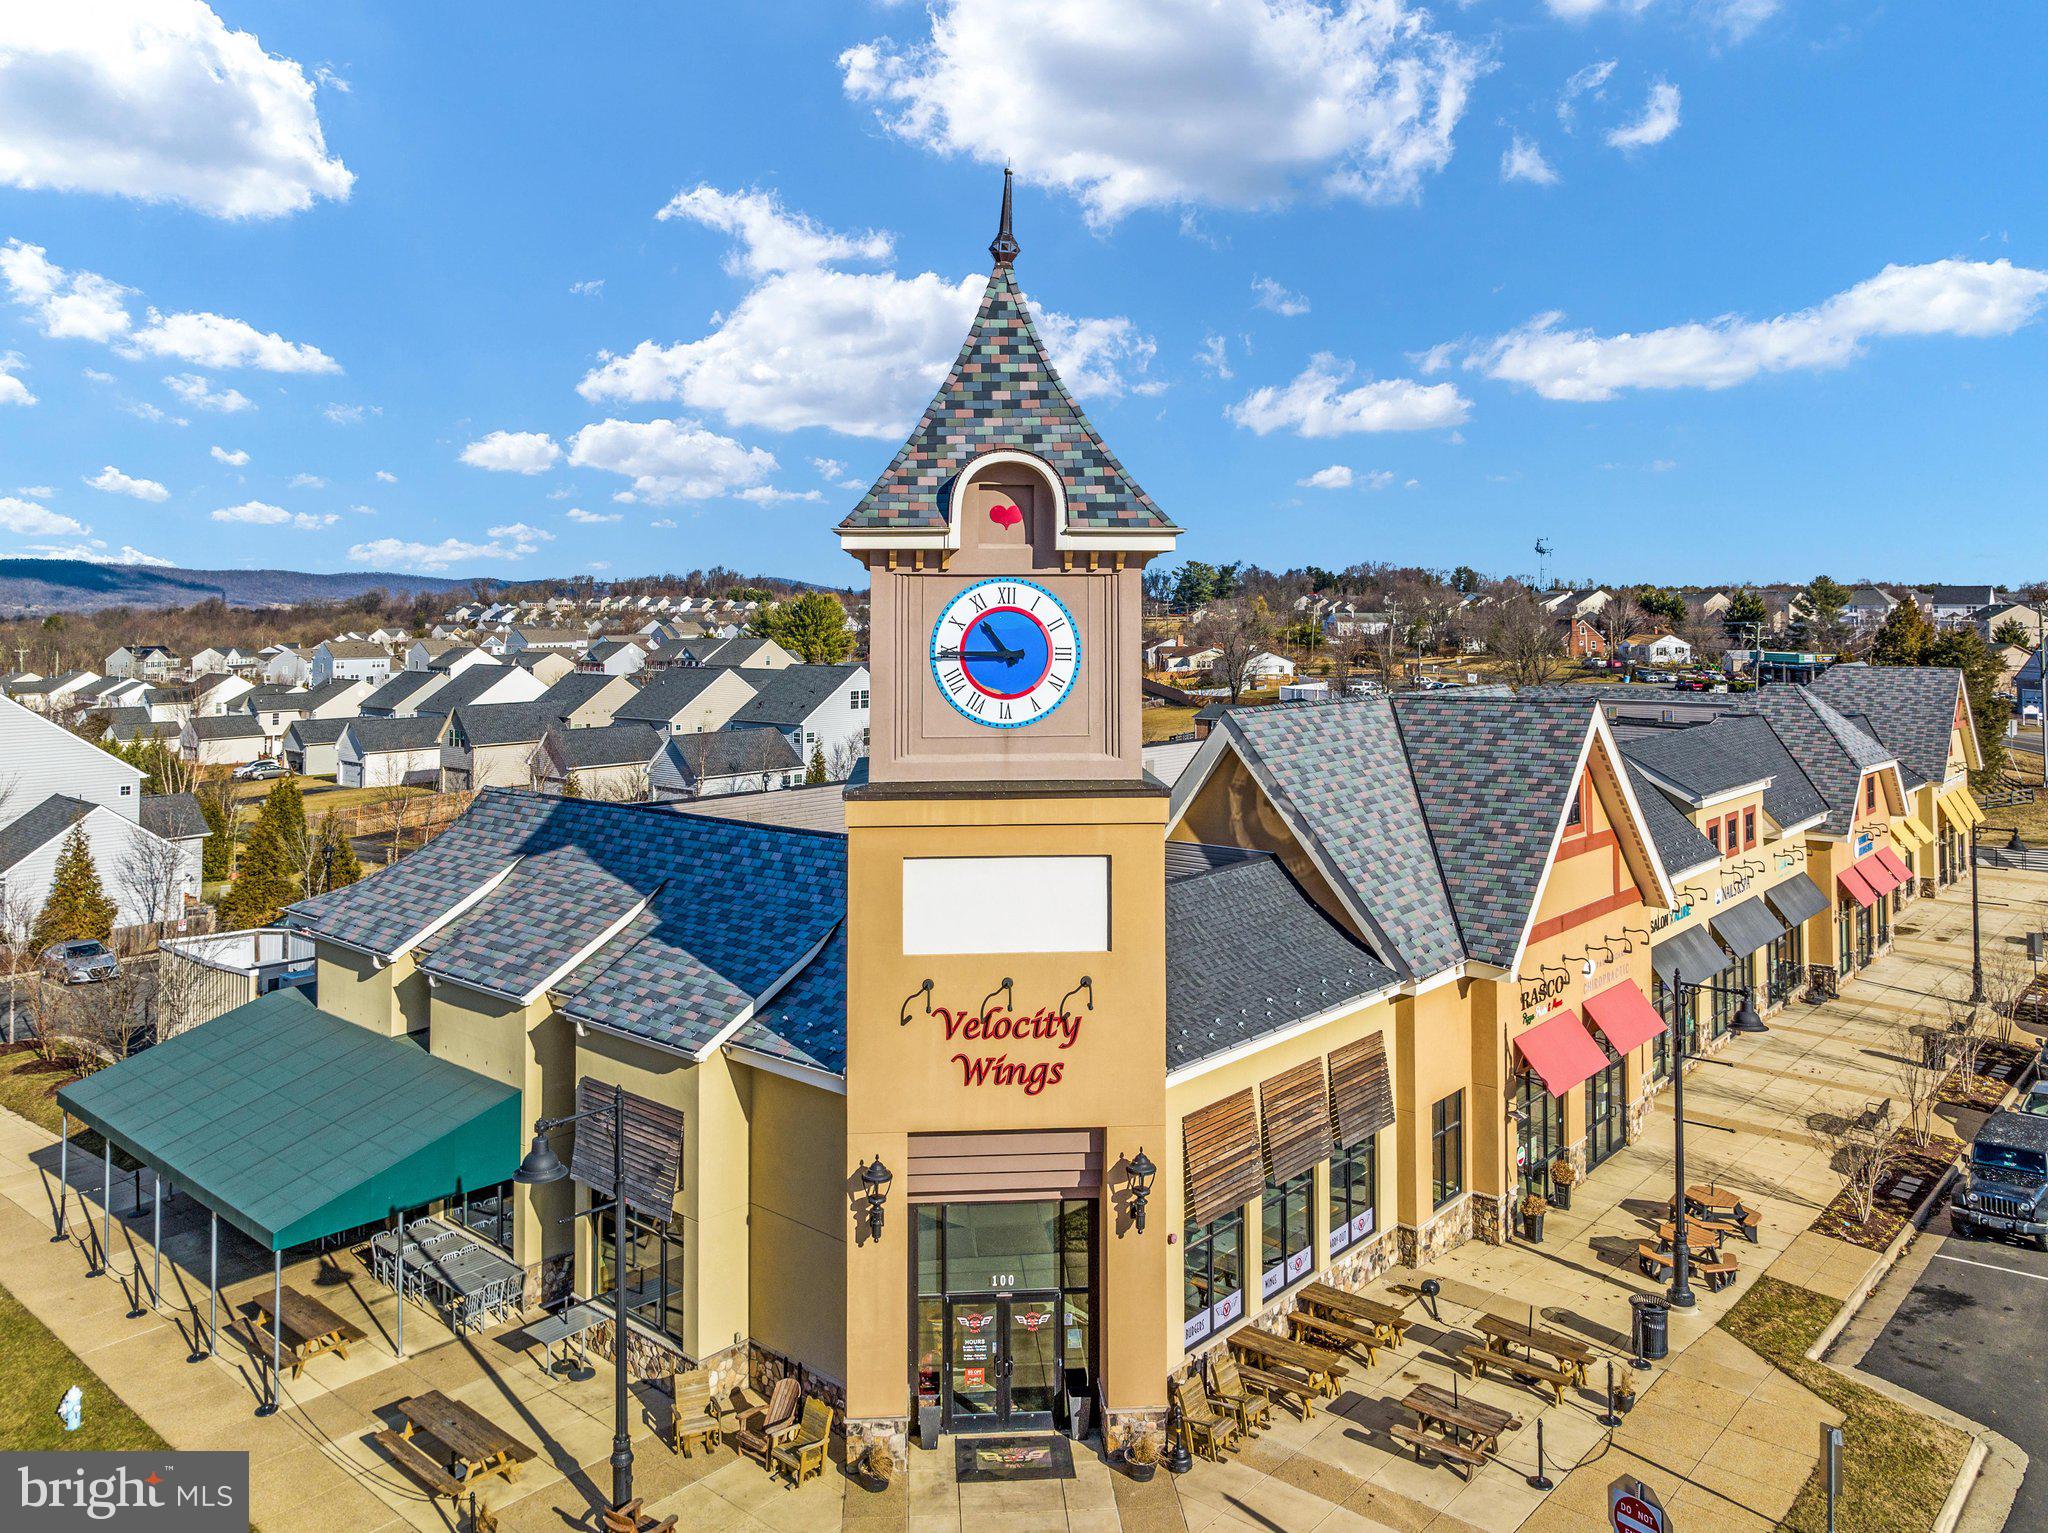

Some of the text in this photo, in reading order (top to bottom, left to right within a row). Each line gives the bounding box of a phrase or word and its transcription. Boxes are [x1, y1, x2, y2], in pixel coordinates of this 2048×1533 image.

[969, 593, 987, 613] XI
[998, 587, 1016, 604] XII
[1030, 596, 1041, 611] I
[948, 616, 966, 631] X
[1047, 617, 1065, 632] II
[1055, 647, 1072, 661] III
[943, 667, 967, 695] VIII
[1047, 673, 1065, 692] IV
[965, 691, 986, 714] VII
[999, 702, 1012, 719] VI
[1030, 696, 1041, 712] V
[1650, 913, 1669, 934] SALON
[1520, 975, 1565, 1011] RASCO
[931, 1006, 1082, 1049] Velocity
[951, 1053, 1065, 1096] Wings
[992, 1275, 1014, 1287] 100
[1185, 1318, 1205, 1340] BURGERS
[1620, 1502, 1653, 1526] DO NOT
